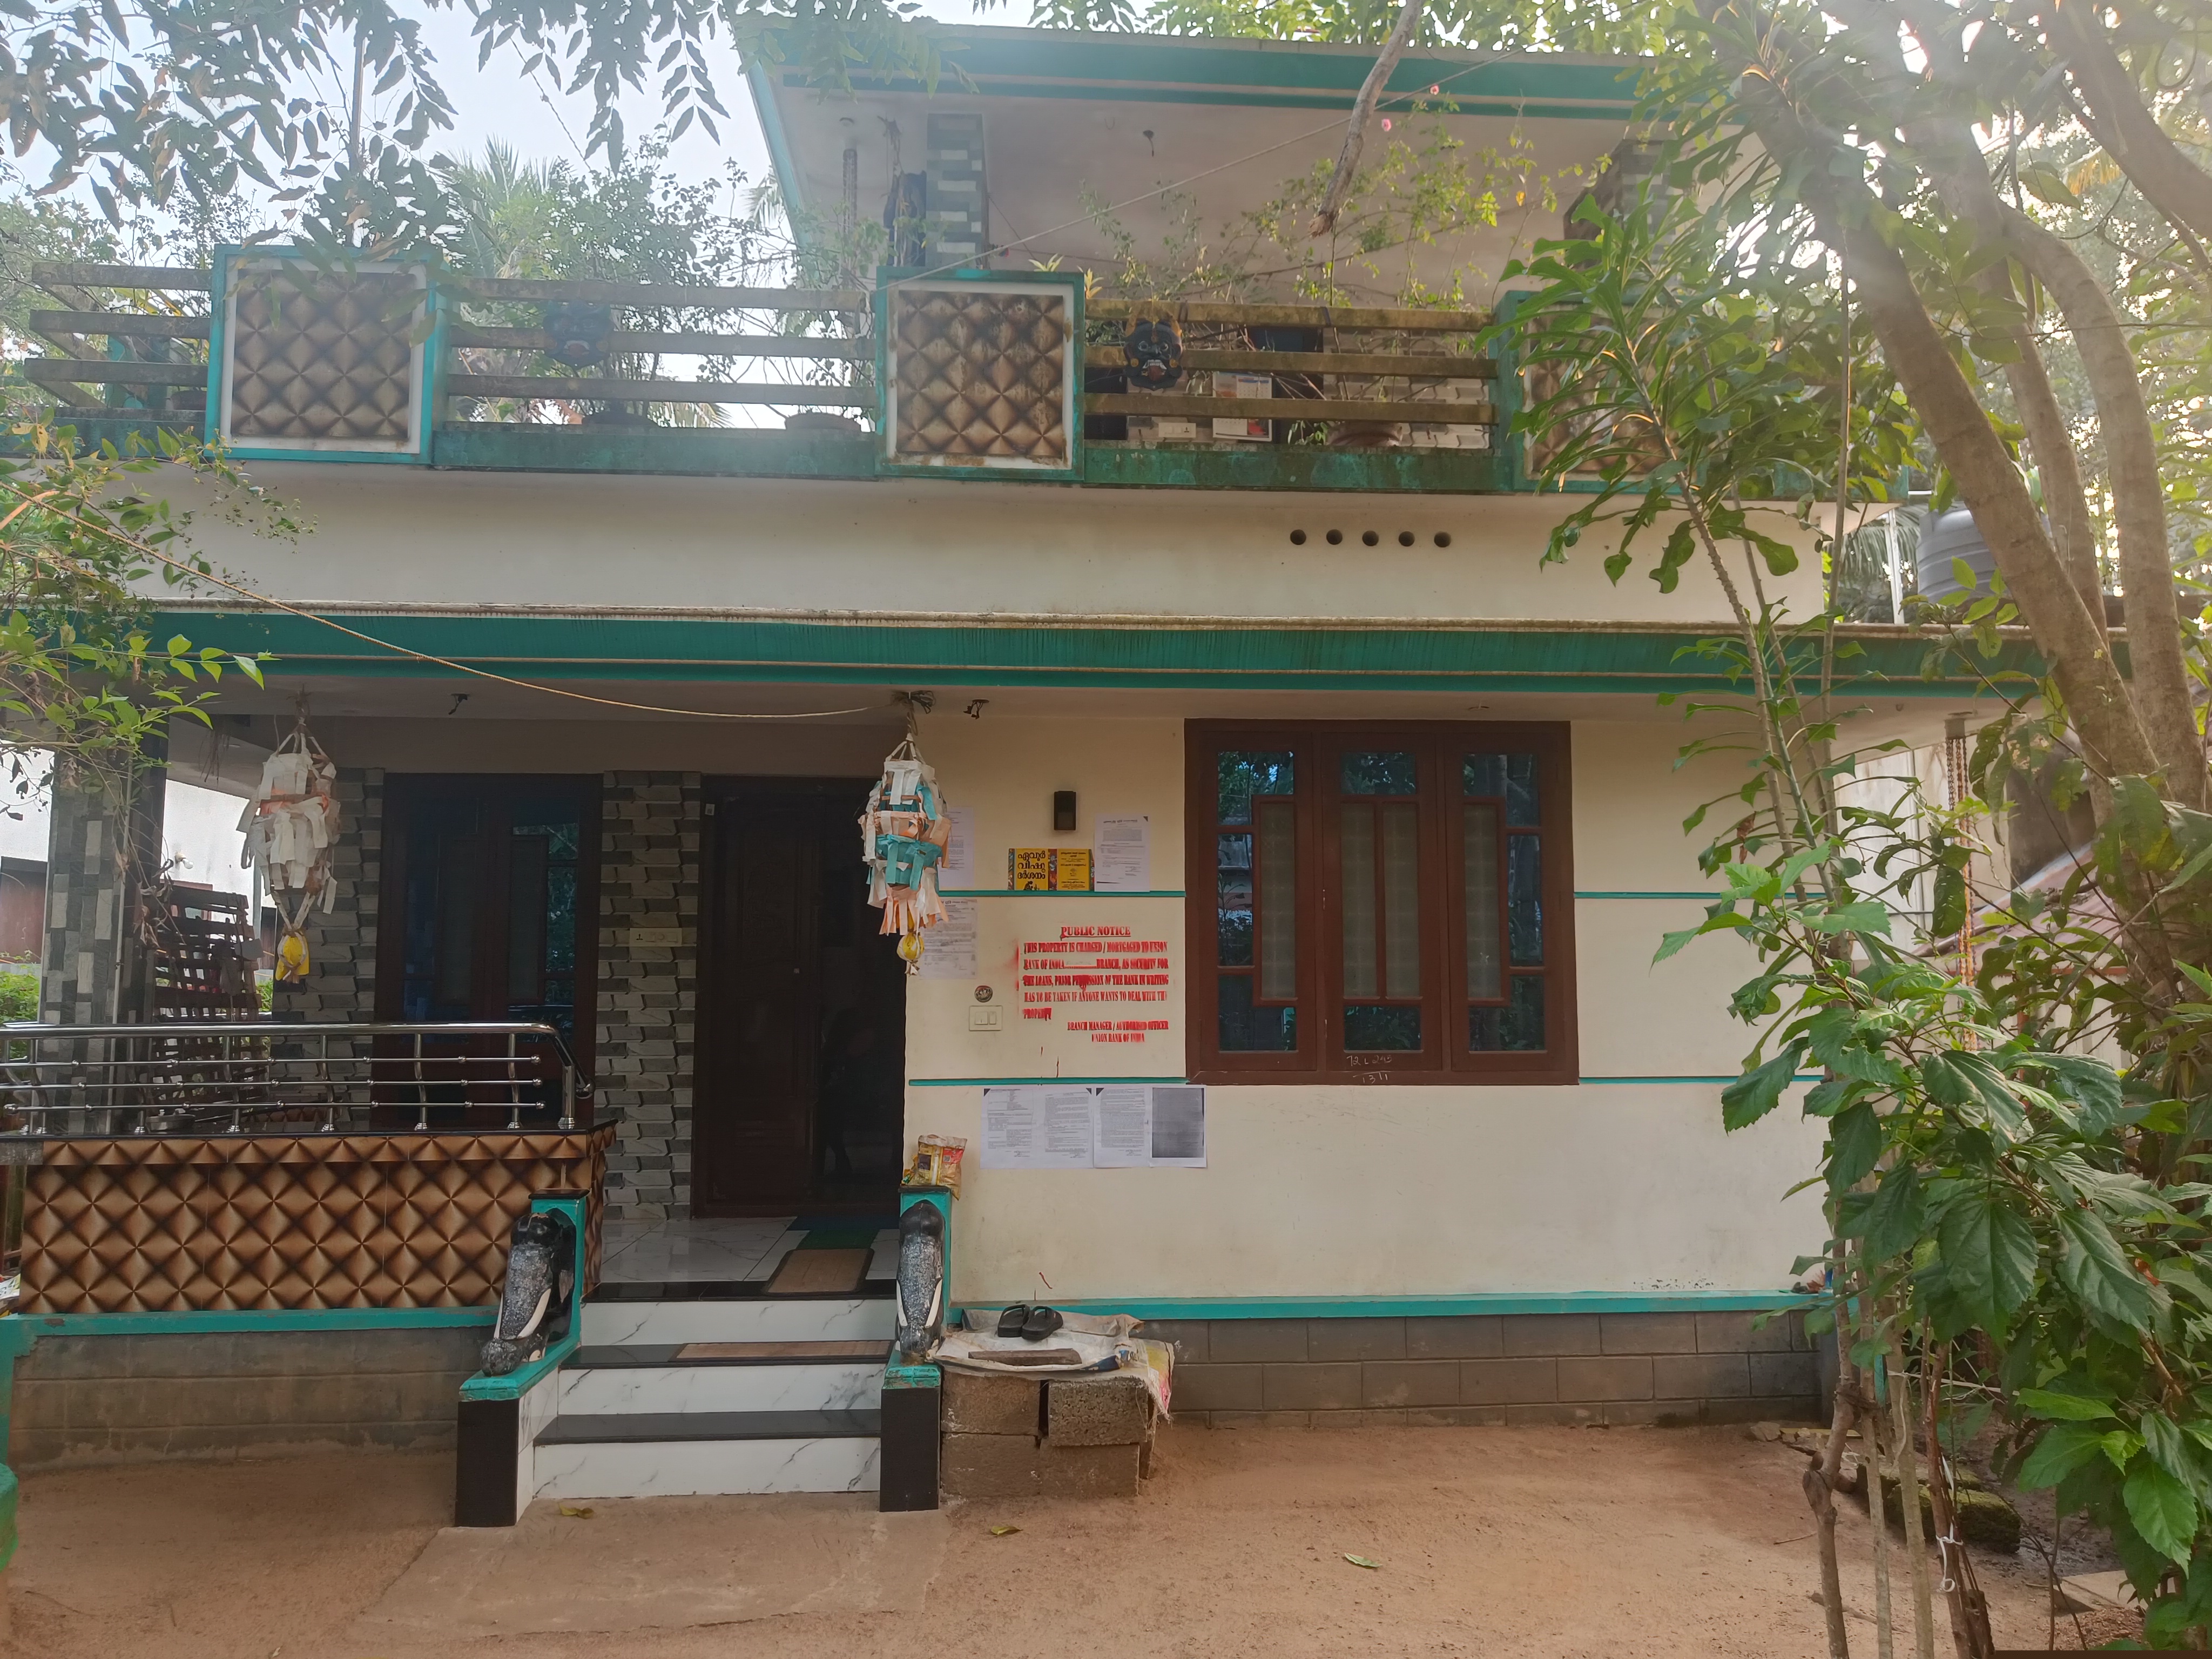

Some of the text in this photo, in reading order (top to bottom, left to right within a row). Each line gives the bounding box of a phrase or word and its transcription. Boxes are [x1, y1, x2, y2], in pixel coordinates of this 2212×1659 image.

[1061, 926, 1130, 936] PUBLIC NOTICE
[1024, 942, 1037, 953] THIS
[1038, 942, 1068, 953] PROPERTY
[1069, 942, 1075, 952] IS
[1076, 942, 1102, 952] CHARGED
[1107, 942, 1140, 952] MORTGAGED
[1141, 941, 1149, 953] TO
[1150, 941, 1168, 952] UNION
[1024, 959, 1039, 970] BANK
[1041, 959, 1048, 969] OF
[1122, 959, 1129, 969] AS
[1130, 958, 1156, 969] SECURITY
[1157, 958, 1169, 969] FOR
[1023, 975, 1169, 987] HE LOANS, PRIOR PESSION OF THE BANK IN WRITING
[1024, 992, 1035, 1002] HAS
[1036, 992, 1043, 1002] TO
[1044, 992, 1051, 1002] BE
[1053, 992, 1071, 1002] TAKEN
[1072, 992, 1077, 1002] IF
[1078, 992, 1100, 1002] ANYONE
[1100, 992, 1118, 1001] WANTS
[1120, 991, 1127, 1001] TO
[1128, 991, 1141, 1001] DEAL
[1142, 991, 1156, 1001] WITH
[1067, 1022, 1088, 1030] BRANCH
[1089, 1021, 1112, 1030] MANAGER
[1148, 1021, 1169, 1030] OFFICER
[1091, 1034, 1108, 1042] UNION
[1108, 1033, 1122, 1042] BANK
[1123, 1033, 1129, 1042] OF
